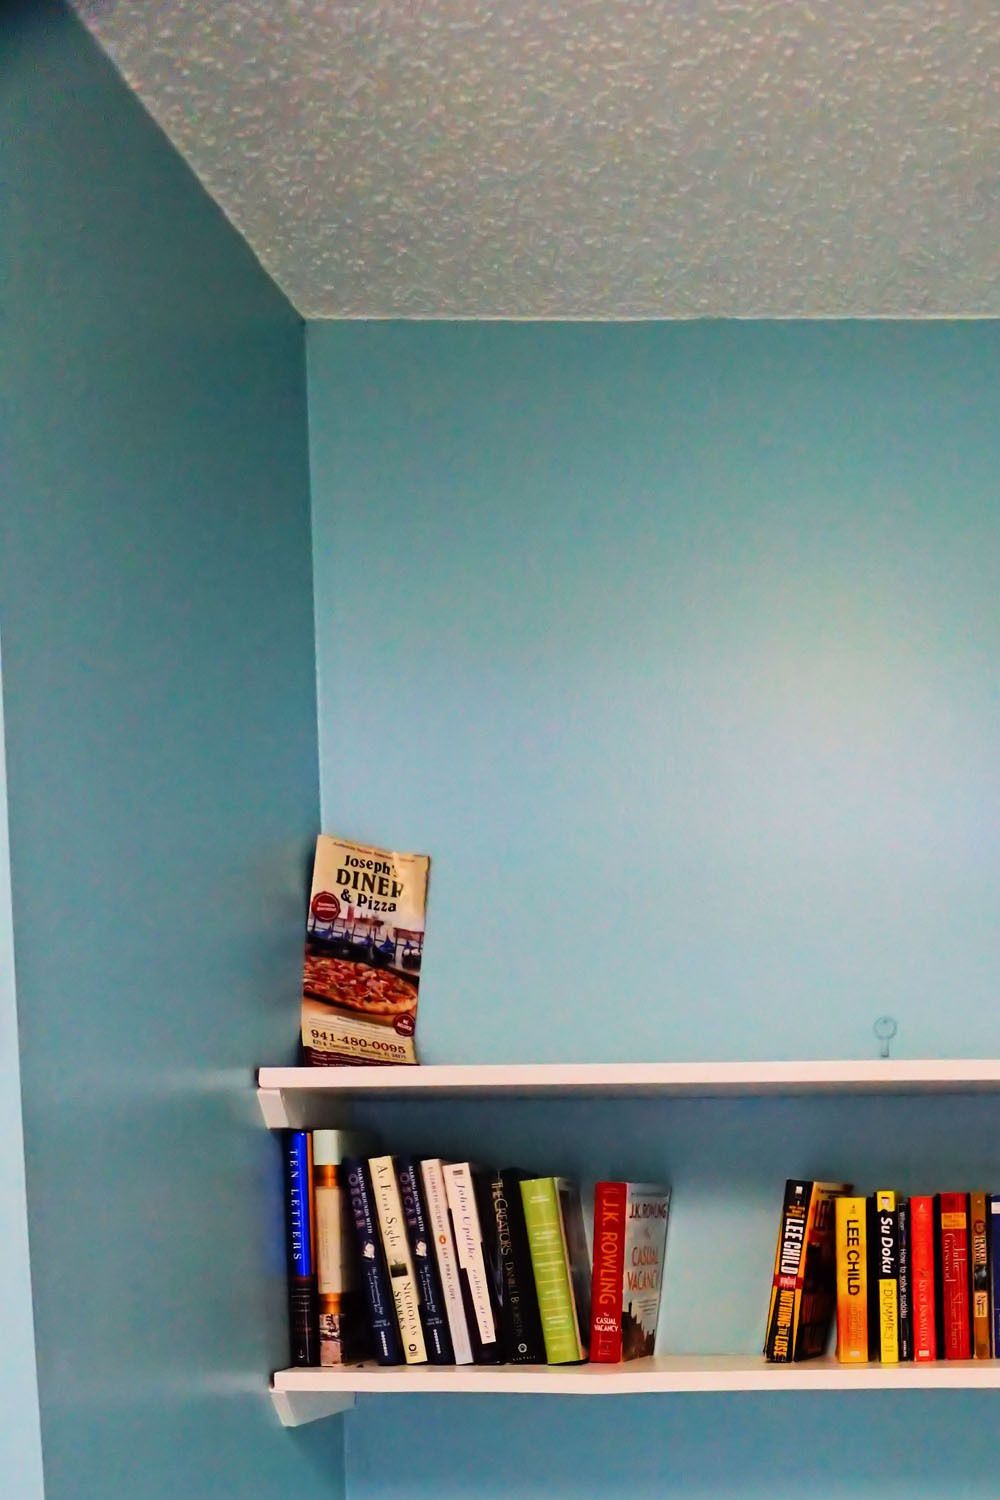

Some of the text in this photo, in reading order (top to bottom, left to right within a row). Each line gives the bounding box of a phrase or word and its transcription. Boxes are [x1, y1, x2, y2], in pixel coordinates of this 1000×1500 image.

[340, 888, 352, 904] &
[356, 893, 397, 912] Pizza
[310, 1029, 406, 1054] 941-480-0095
[290, 1149, 302, 1260] TEN LETTERS
[784, 1218, 804, 1242] LEE
[846, 1219, 860, 1247] LEE
[880, 1217, 893, 1234] Su
[600, 1198, 619, 1305] J.K. ROWLING
[780, 1241, 802, 1276] CHILD
[881, 1237, 894, 1274] Doku
[846, 1249, 860, 1296] CHILD
[776, 1290, 795, 1328] NOTHING
[773, 1332, 789, 1358] LOSE
